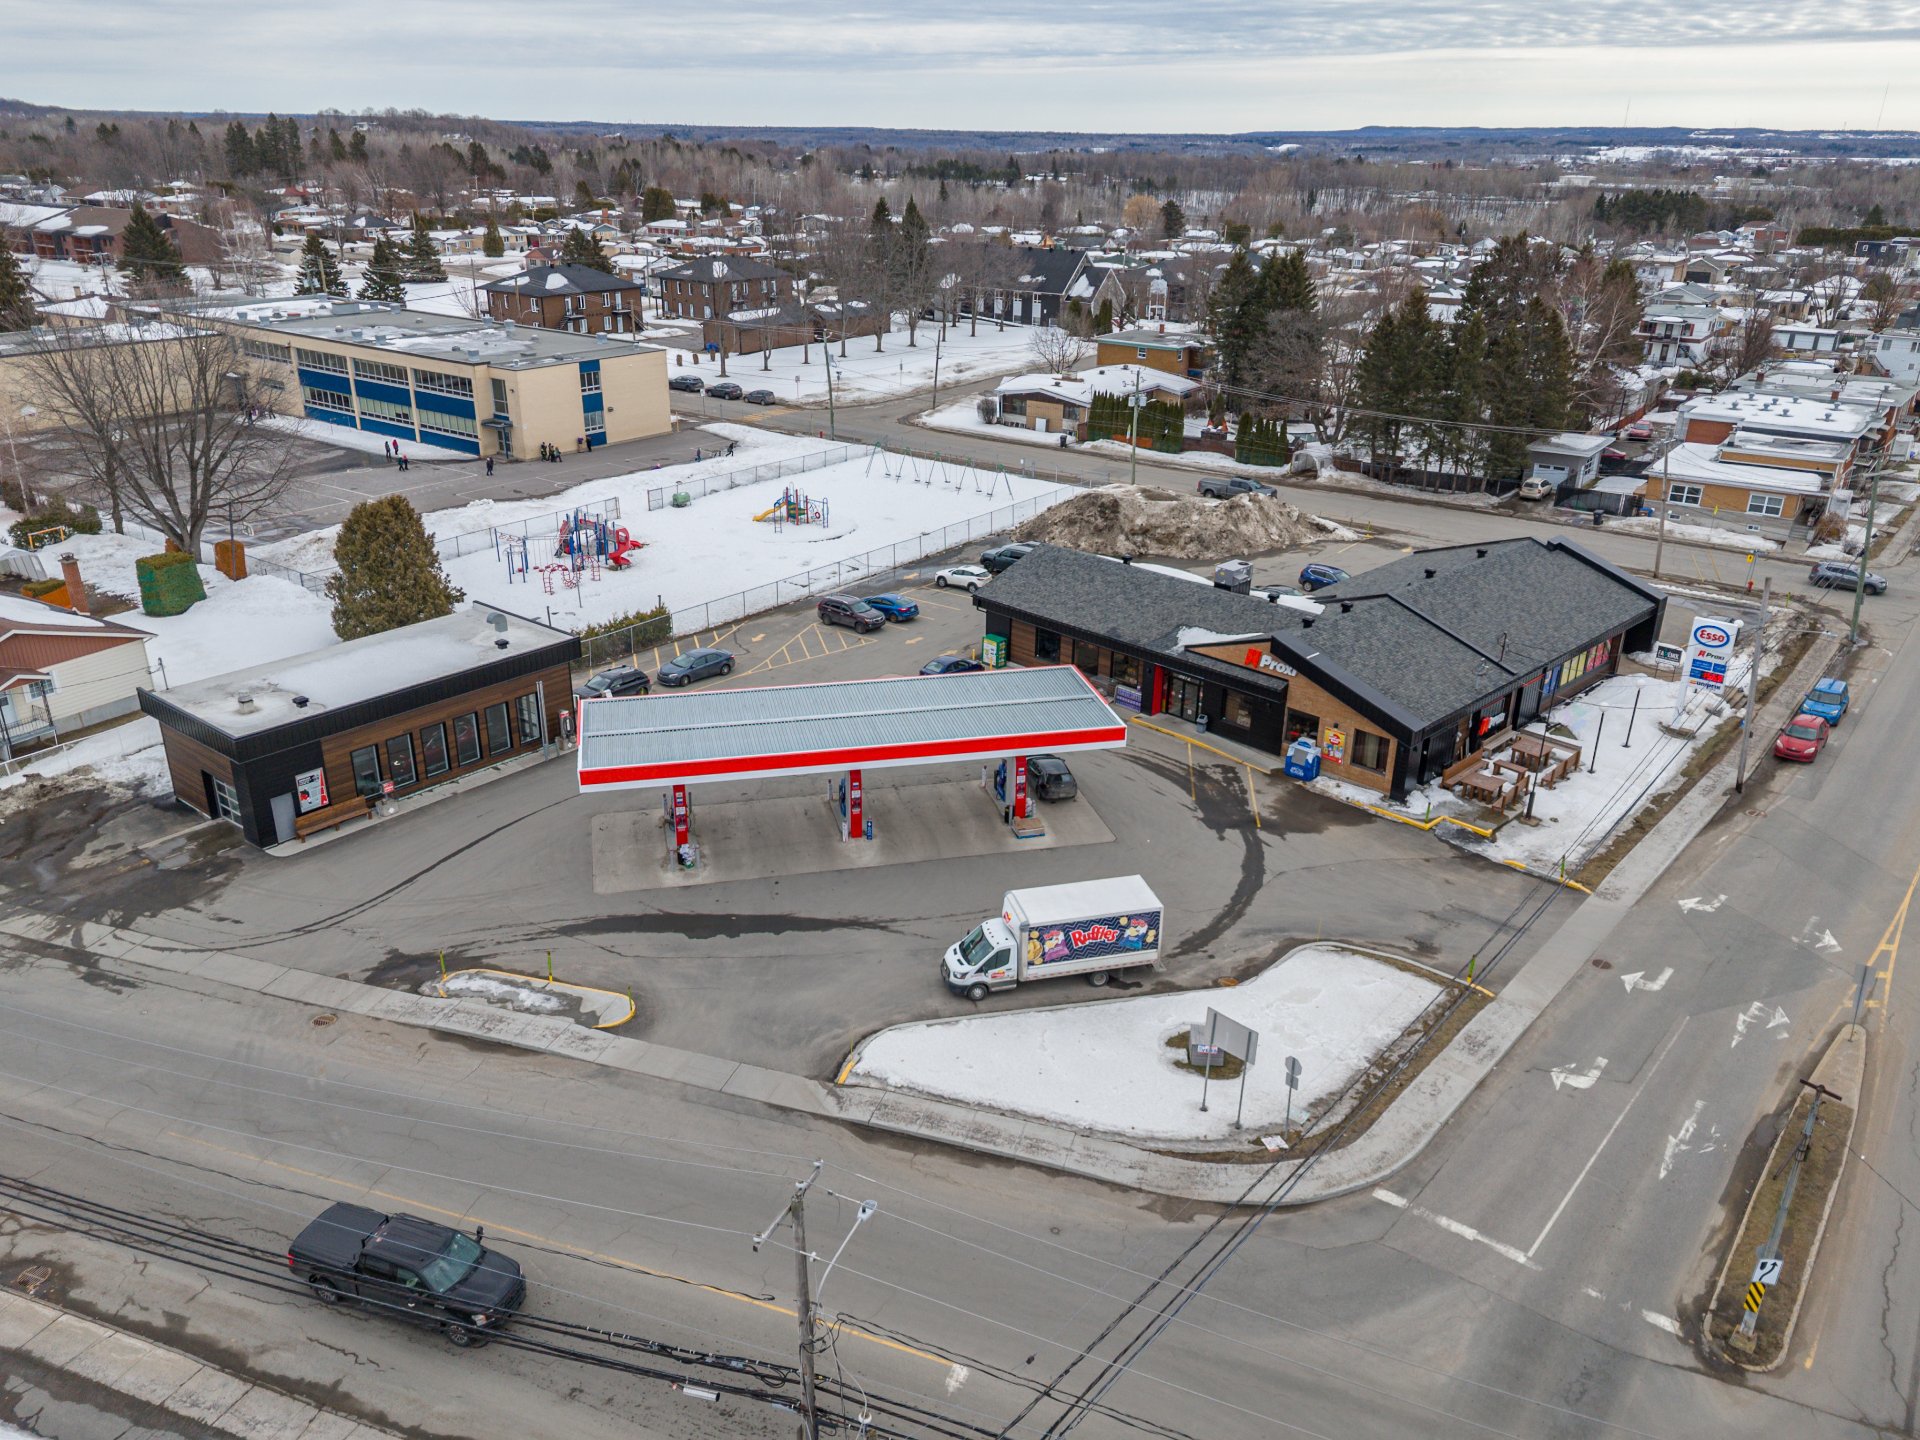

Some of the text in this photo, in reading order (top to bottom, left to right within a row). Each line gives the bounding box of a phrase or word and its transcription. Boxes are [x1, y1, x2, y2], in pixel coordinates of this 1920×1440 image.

[1699, 629, 1725, 643] Esso
[1259, 654, 1297, 677] Proxi
[1070, 925, 1119, 948] Ruffles
